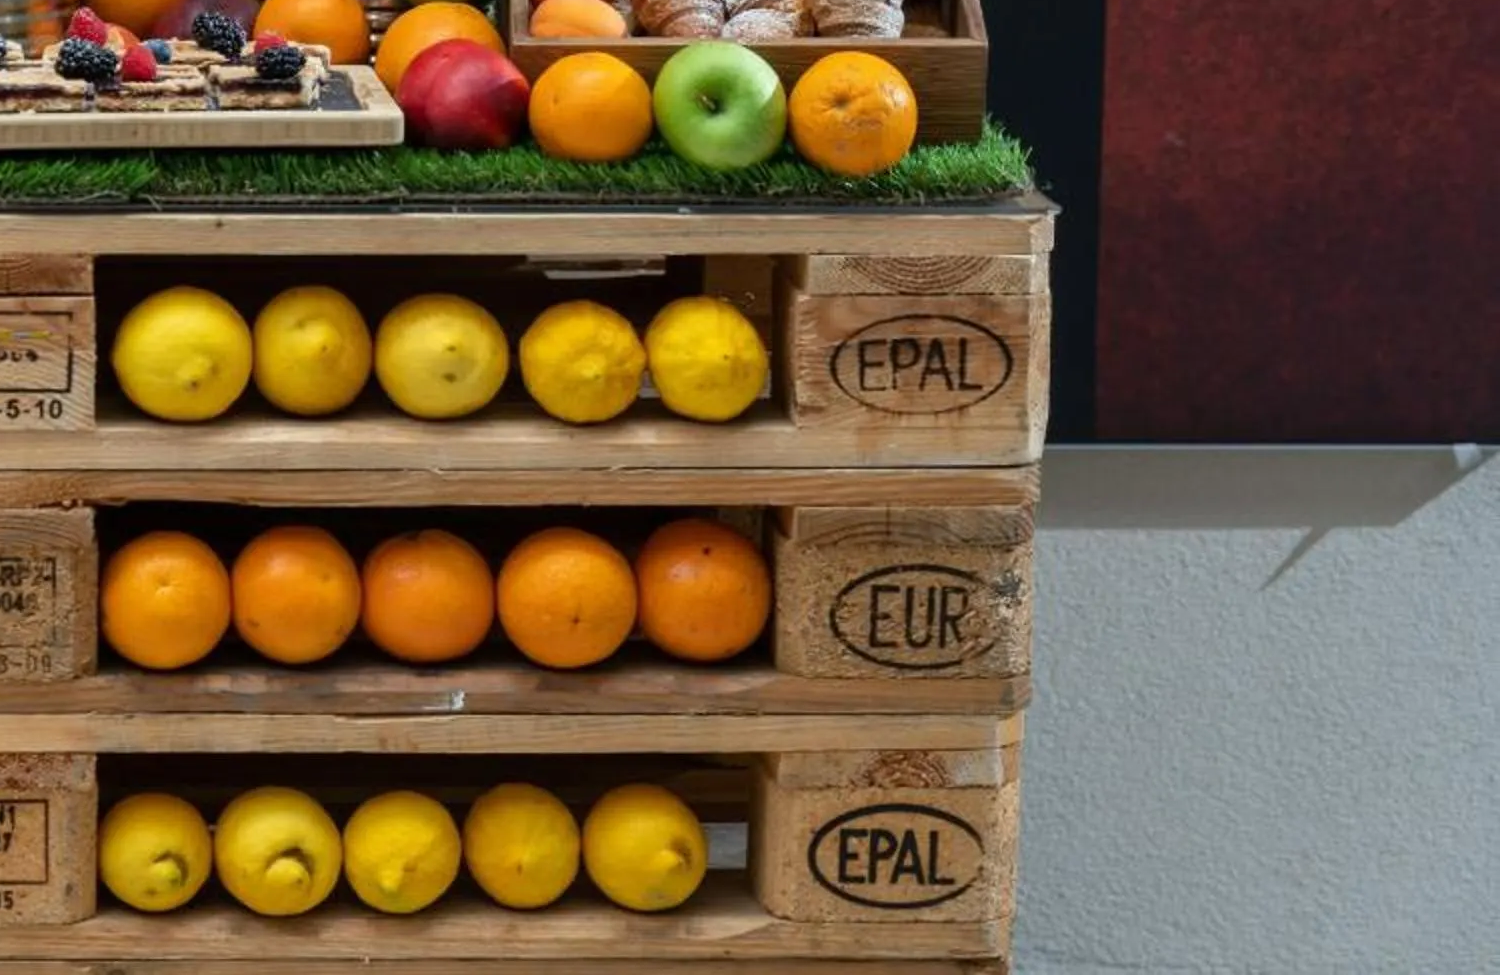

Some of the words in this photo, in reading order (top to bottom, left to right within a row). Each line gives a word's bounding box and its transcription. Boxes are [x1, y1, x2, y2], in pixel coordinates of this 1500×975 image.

[857, 338, 983, 391] EPAL
[869, 584, 970, 648] EUR
[838, 828, 955, 885] EPAL
